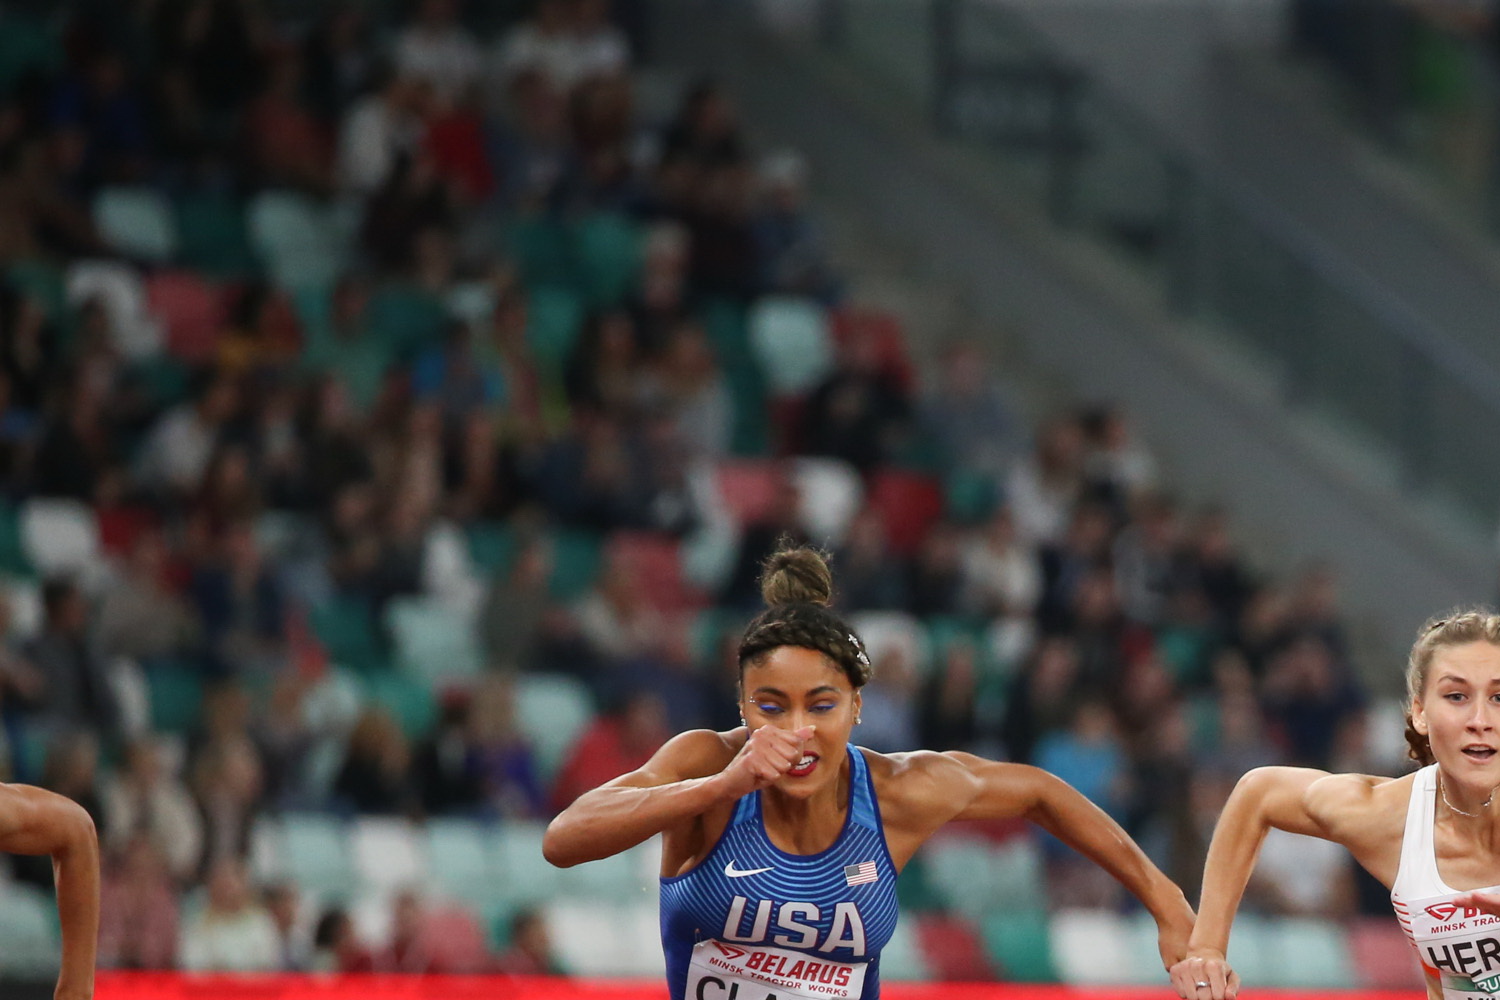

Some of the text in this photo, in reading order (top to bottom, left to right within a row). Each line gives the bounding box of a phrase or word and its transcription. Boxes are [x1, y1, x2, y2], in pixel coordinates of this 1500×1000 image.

[722, 895, 866, 957] USA
[1431, 921, 1467, 934] MINSK
[709, 957, 848, 997] MINSK TRACTOR WORKS
[745, 952, 853, 986] BELARUS
